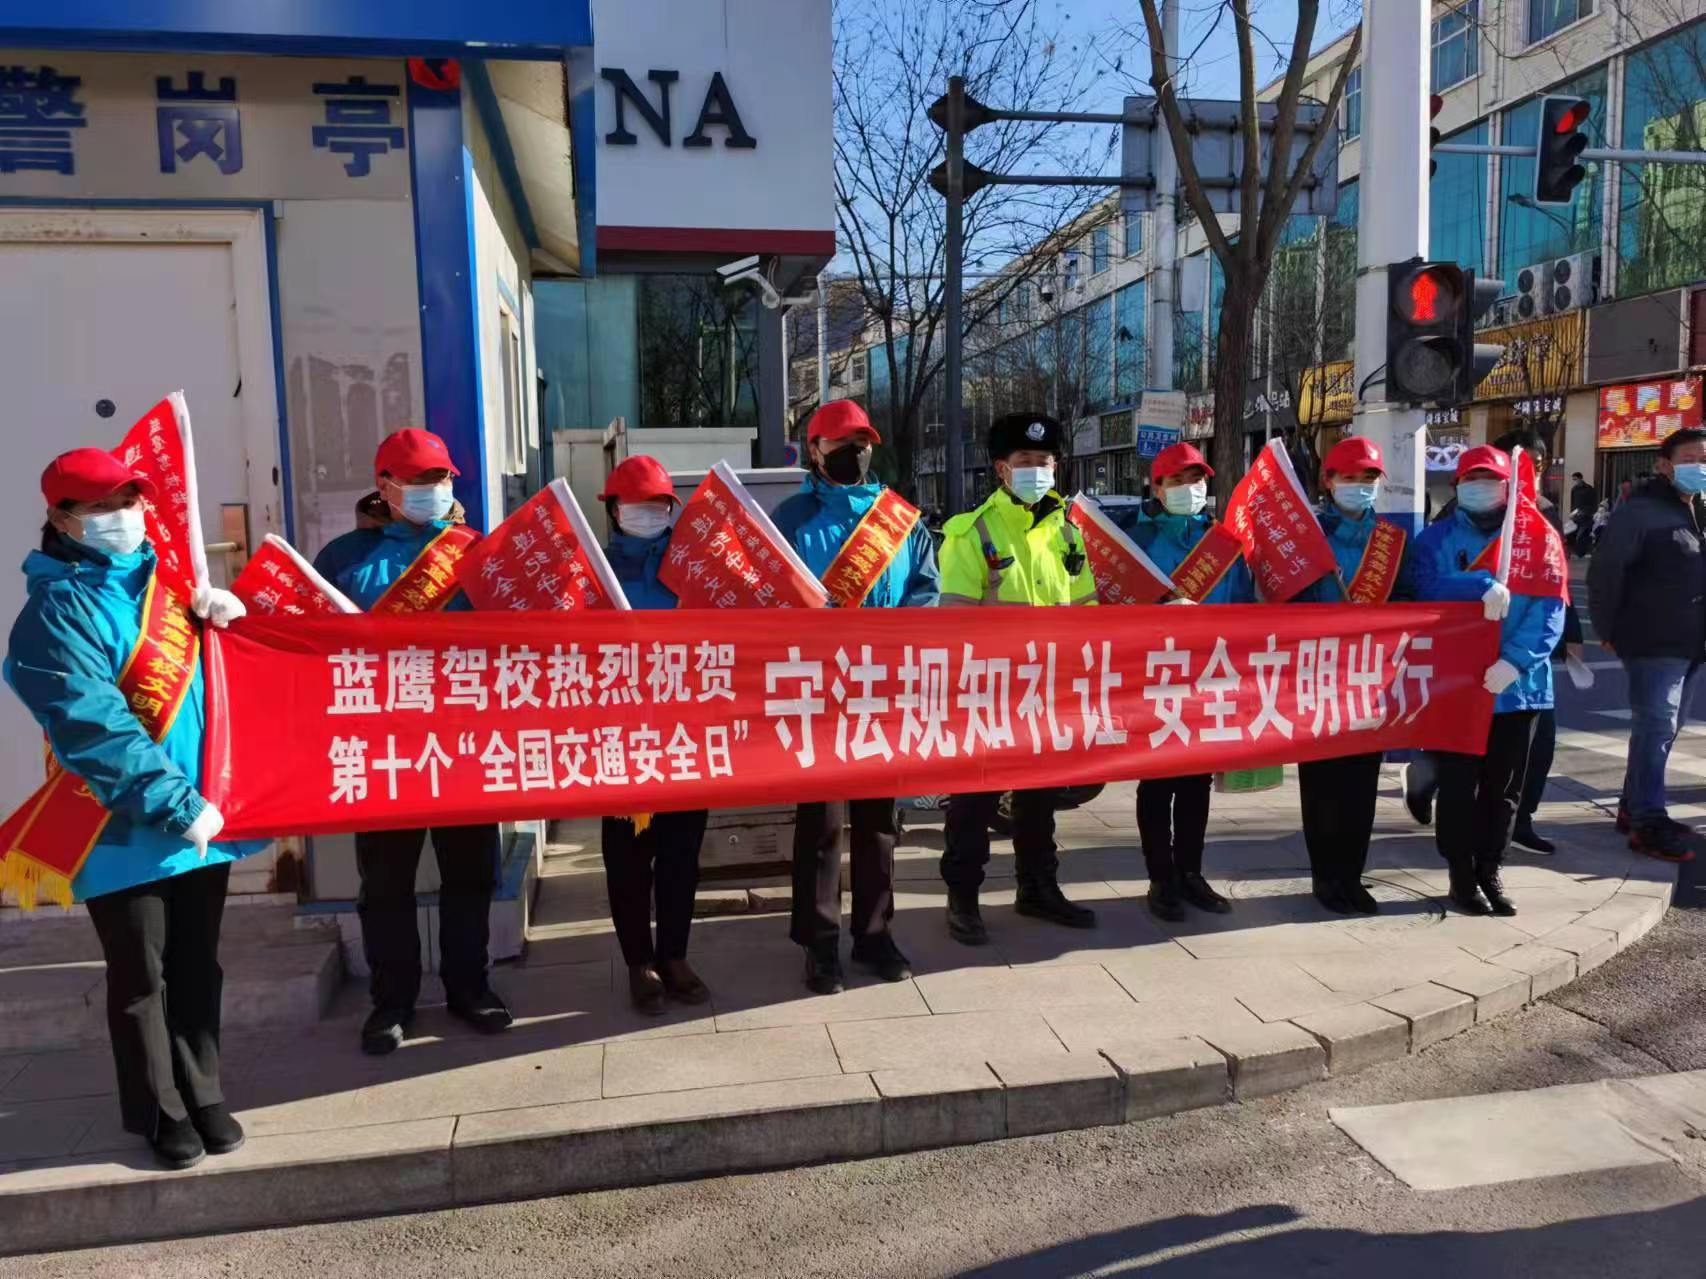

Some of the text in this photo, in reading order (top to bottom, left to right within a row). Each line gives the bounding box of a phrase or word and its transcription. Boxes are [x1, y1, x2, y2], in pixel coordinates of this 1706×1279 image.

[601, 68, 757, 149] NA
[327, 641, 737, 715] 蓝鹰驾校热烈祝贺
[764, 633, 1433, 768] 守法规知礼让 安全文明出行
